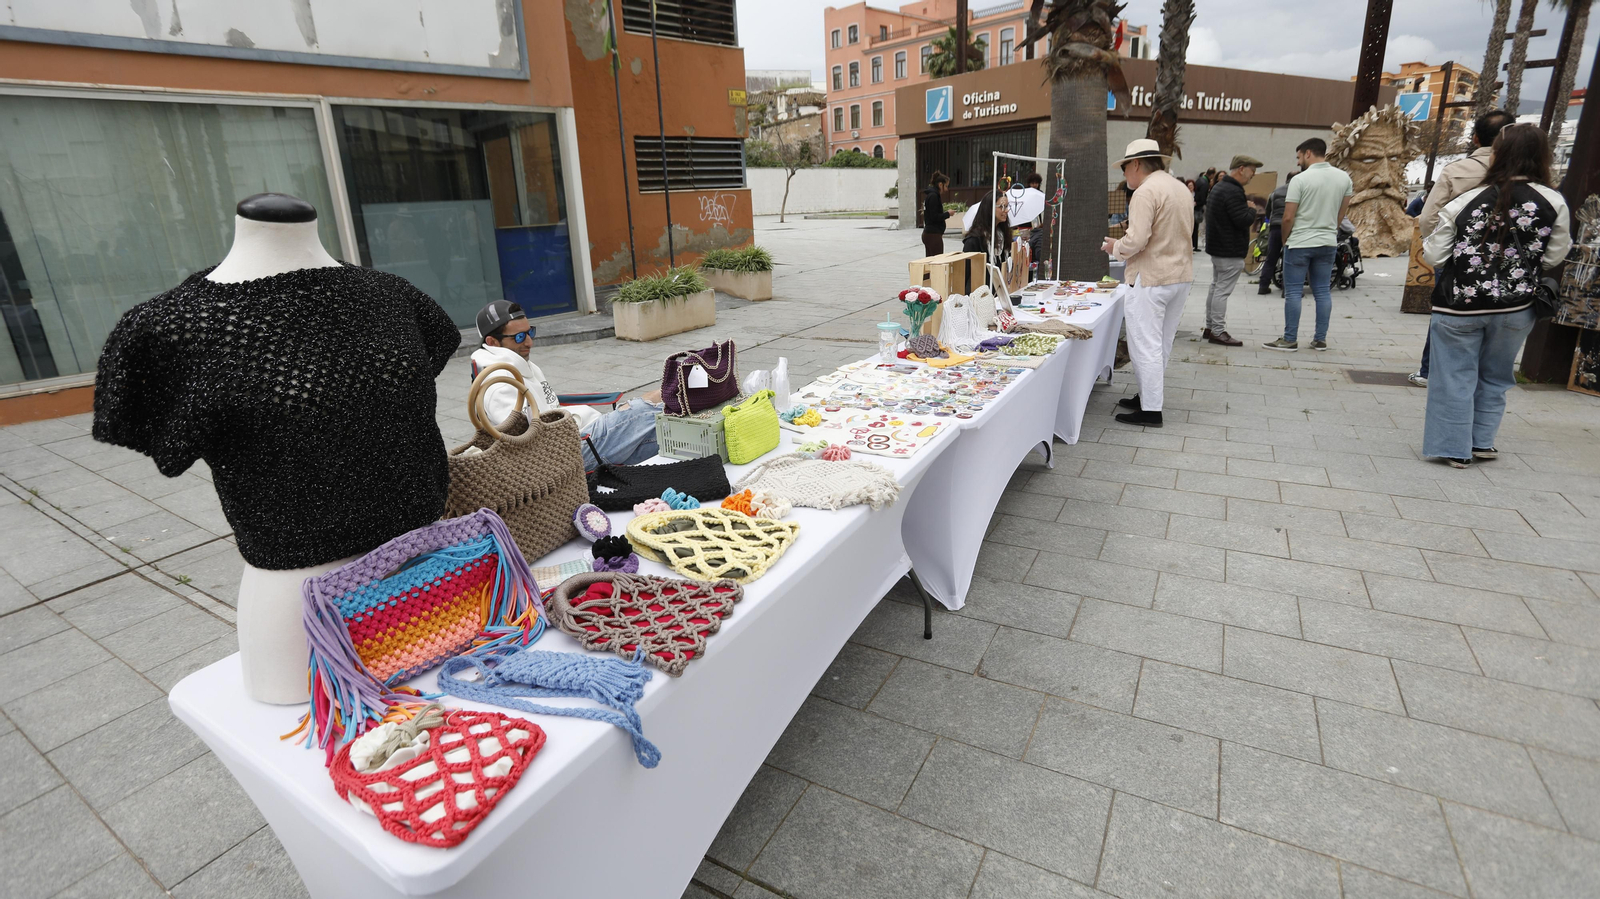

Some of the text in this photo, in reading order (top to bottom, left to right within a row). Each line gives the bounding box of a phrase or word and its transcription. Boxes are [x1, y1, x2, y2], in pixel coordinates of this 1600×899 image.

[963, 90, 1000, 105] Oficina
[1180, 91, 1252, 112] de Turismo
[962, 103, 1018, 119] de Turismo
